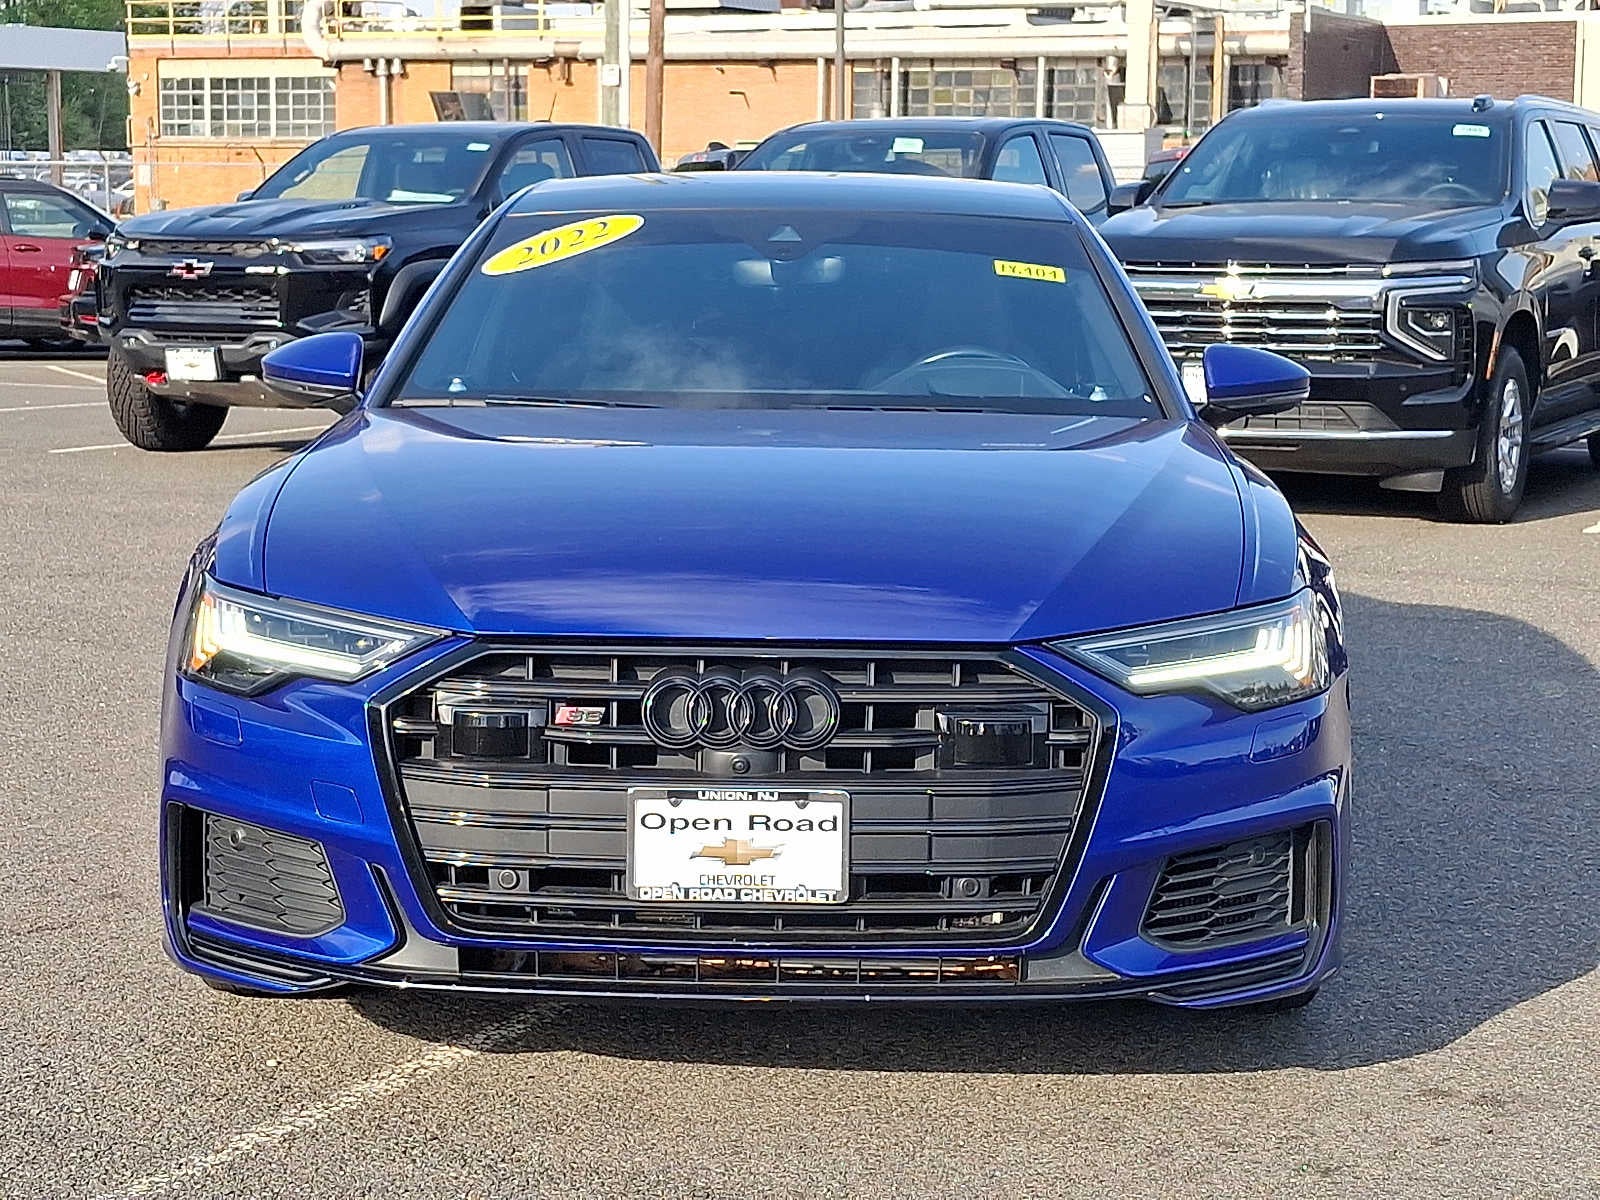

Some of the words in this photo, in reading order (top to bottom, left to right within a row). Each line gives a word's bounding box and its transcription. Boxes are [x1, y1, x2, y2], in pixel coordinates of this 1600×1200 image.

[517, 221, 609, 265] 2022
[757, 791, 779, 801] NJ
[640, 812, 733, 835] Open
[748, 814, 838, 832] Road
[699, 874, 777, 886] CHEVROLET
[639, 887, 685, 900] OPEN
[689, 889, 735, 901] ROAD
[739, 888, 837, 902] CHEVROLET
